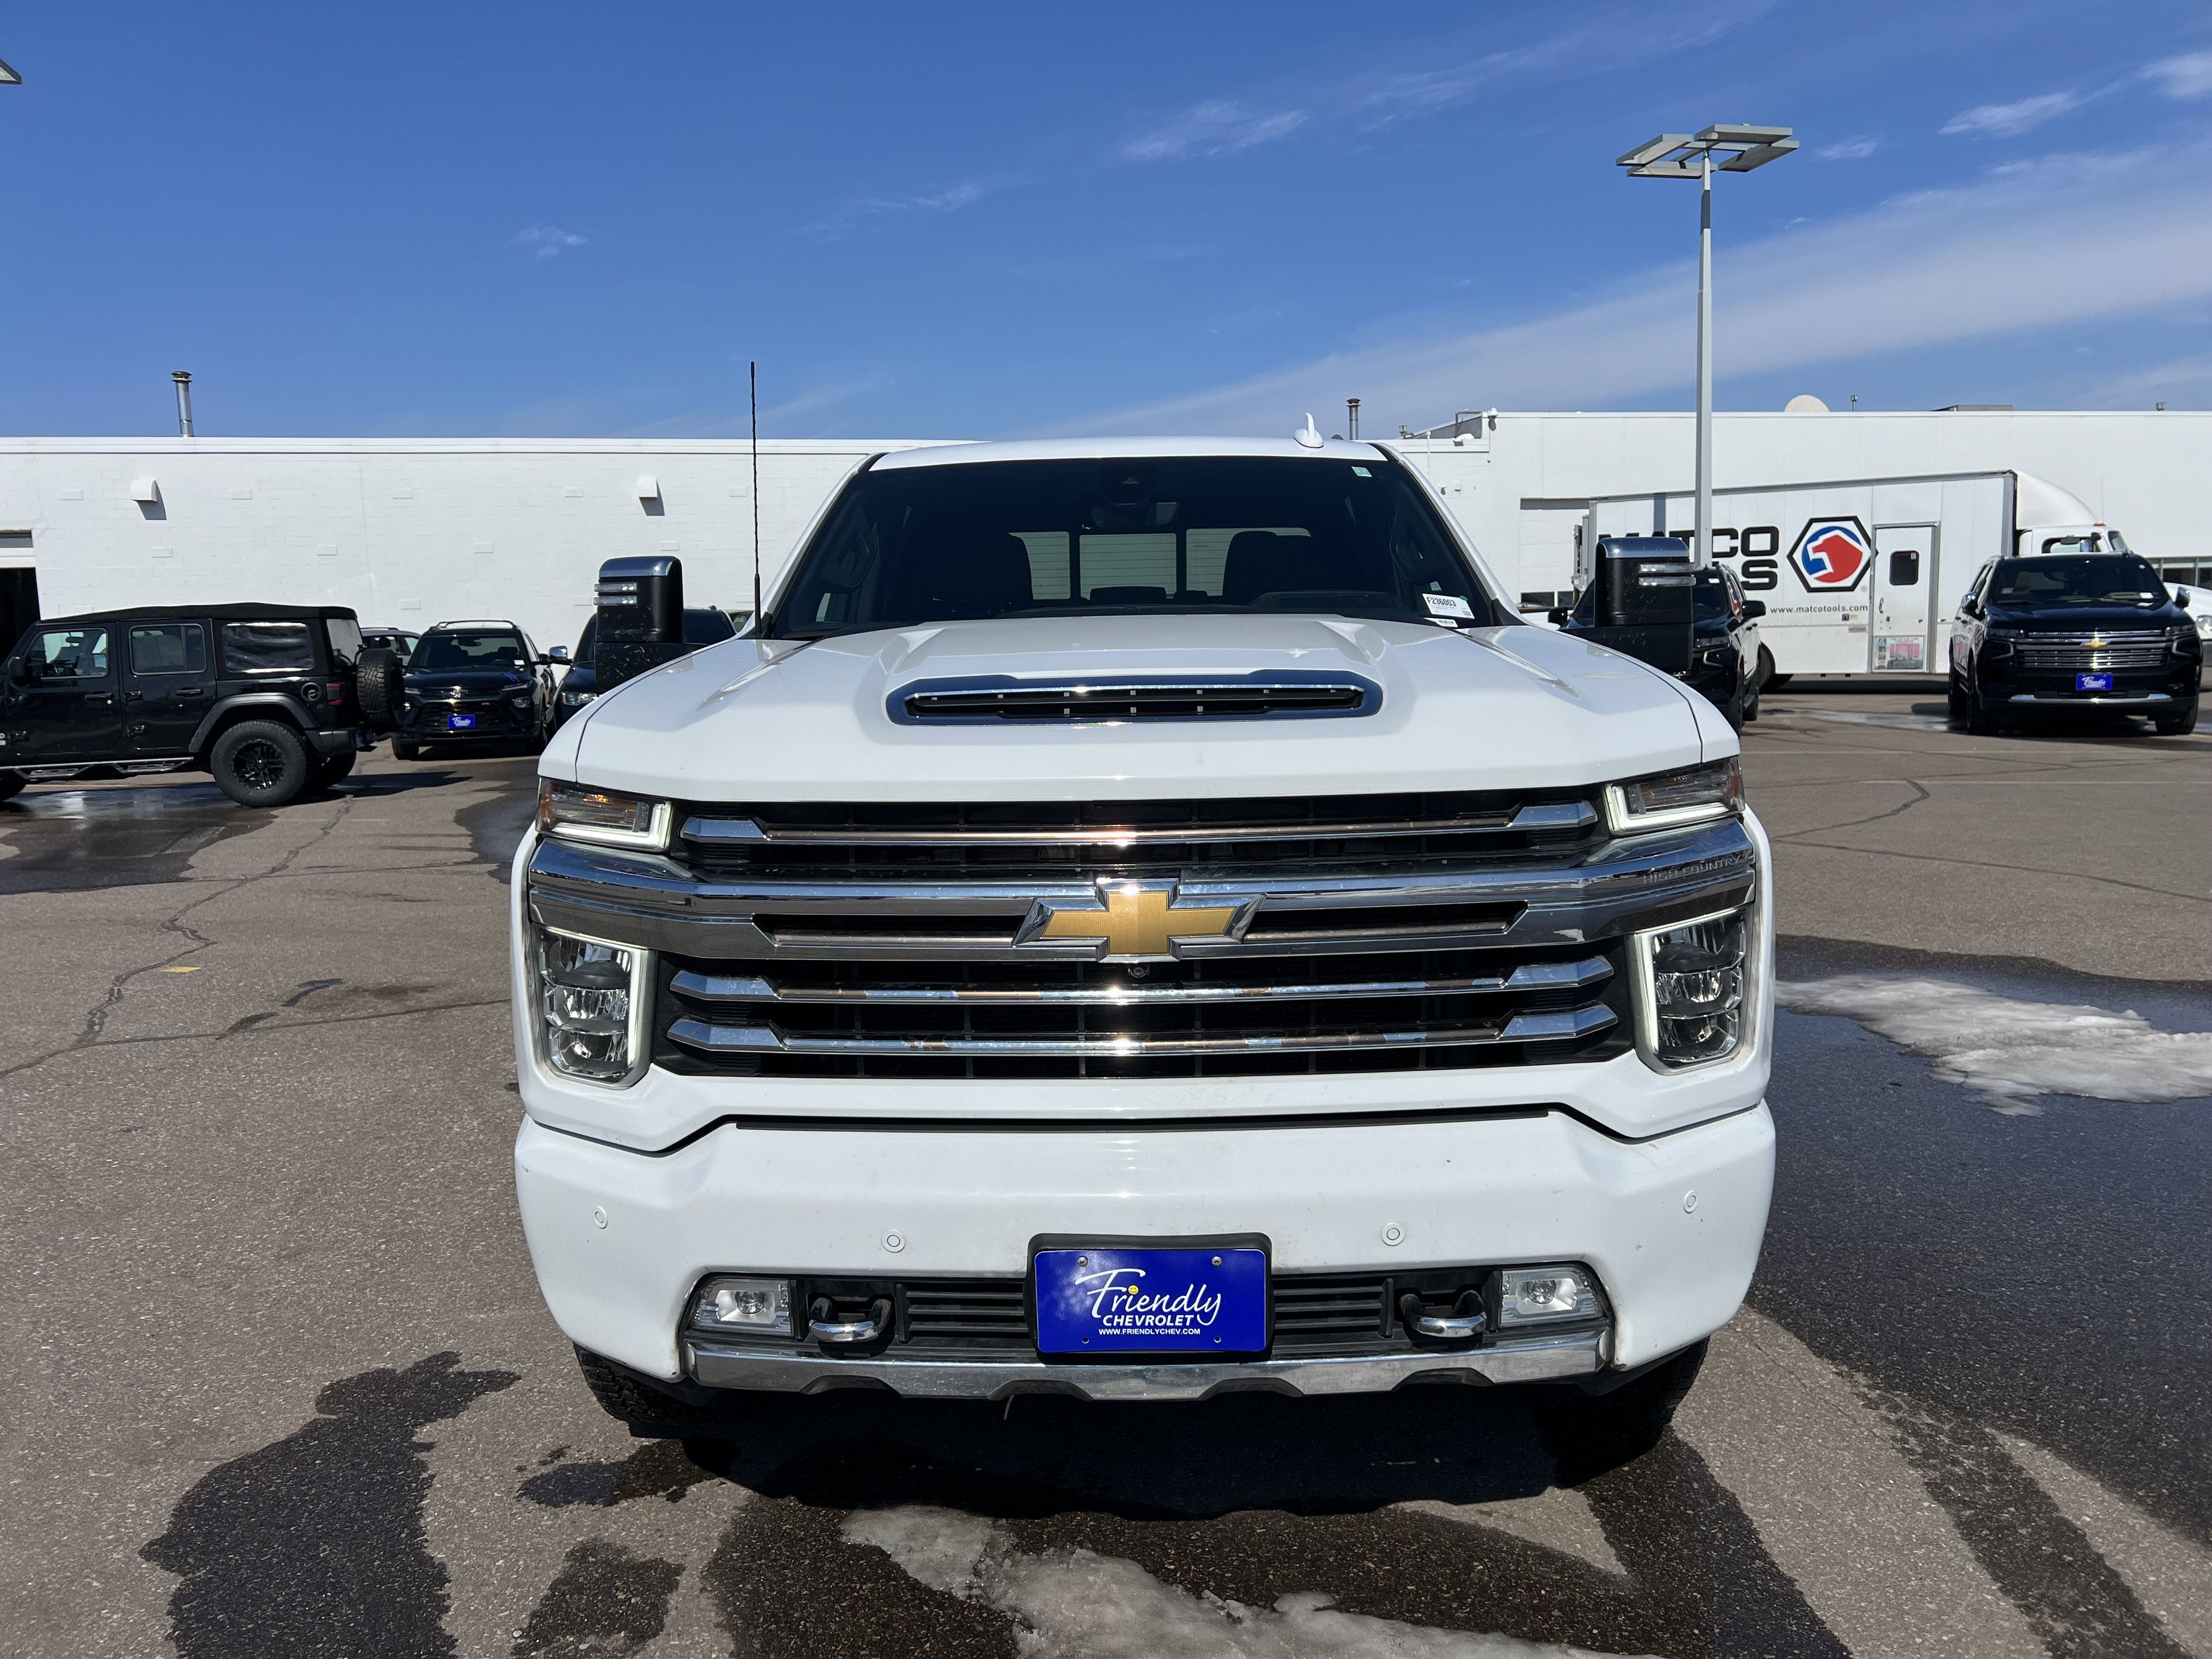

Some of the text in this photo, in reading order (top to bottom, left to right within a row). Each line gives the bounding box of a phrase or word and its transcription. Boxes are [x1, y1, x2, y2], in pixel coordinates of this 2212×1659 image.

[1598, 526, 1779, 558] TCO
[1426, 597, 1456, 606] F236003
[1770, 603, 1868, 614] www.matcotools.com
[1644, 855, 1741, 883] HIGH COUNTRY
[1075, 1268, 1221, 1326] Friendly
[1102, 1314, 1194, 1327] CHEVROLET
